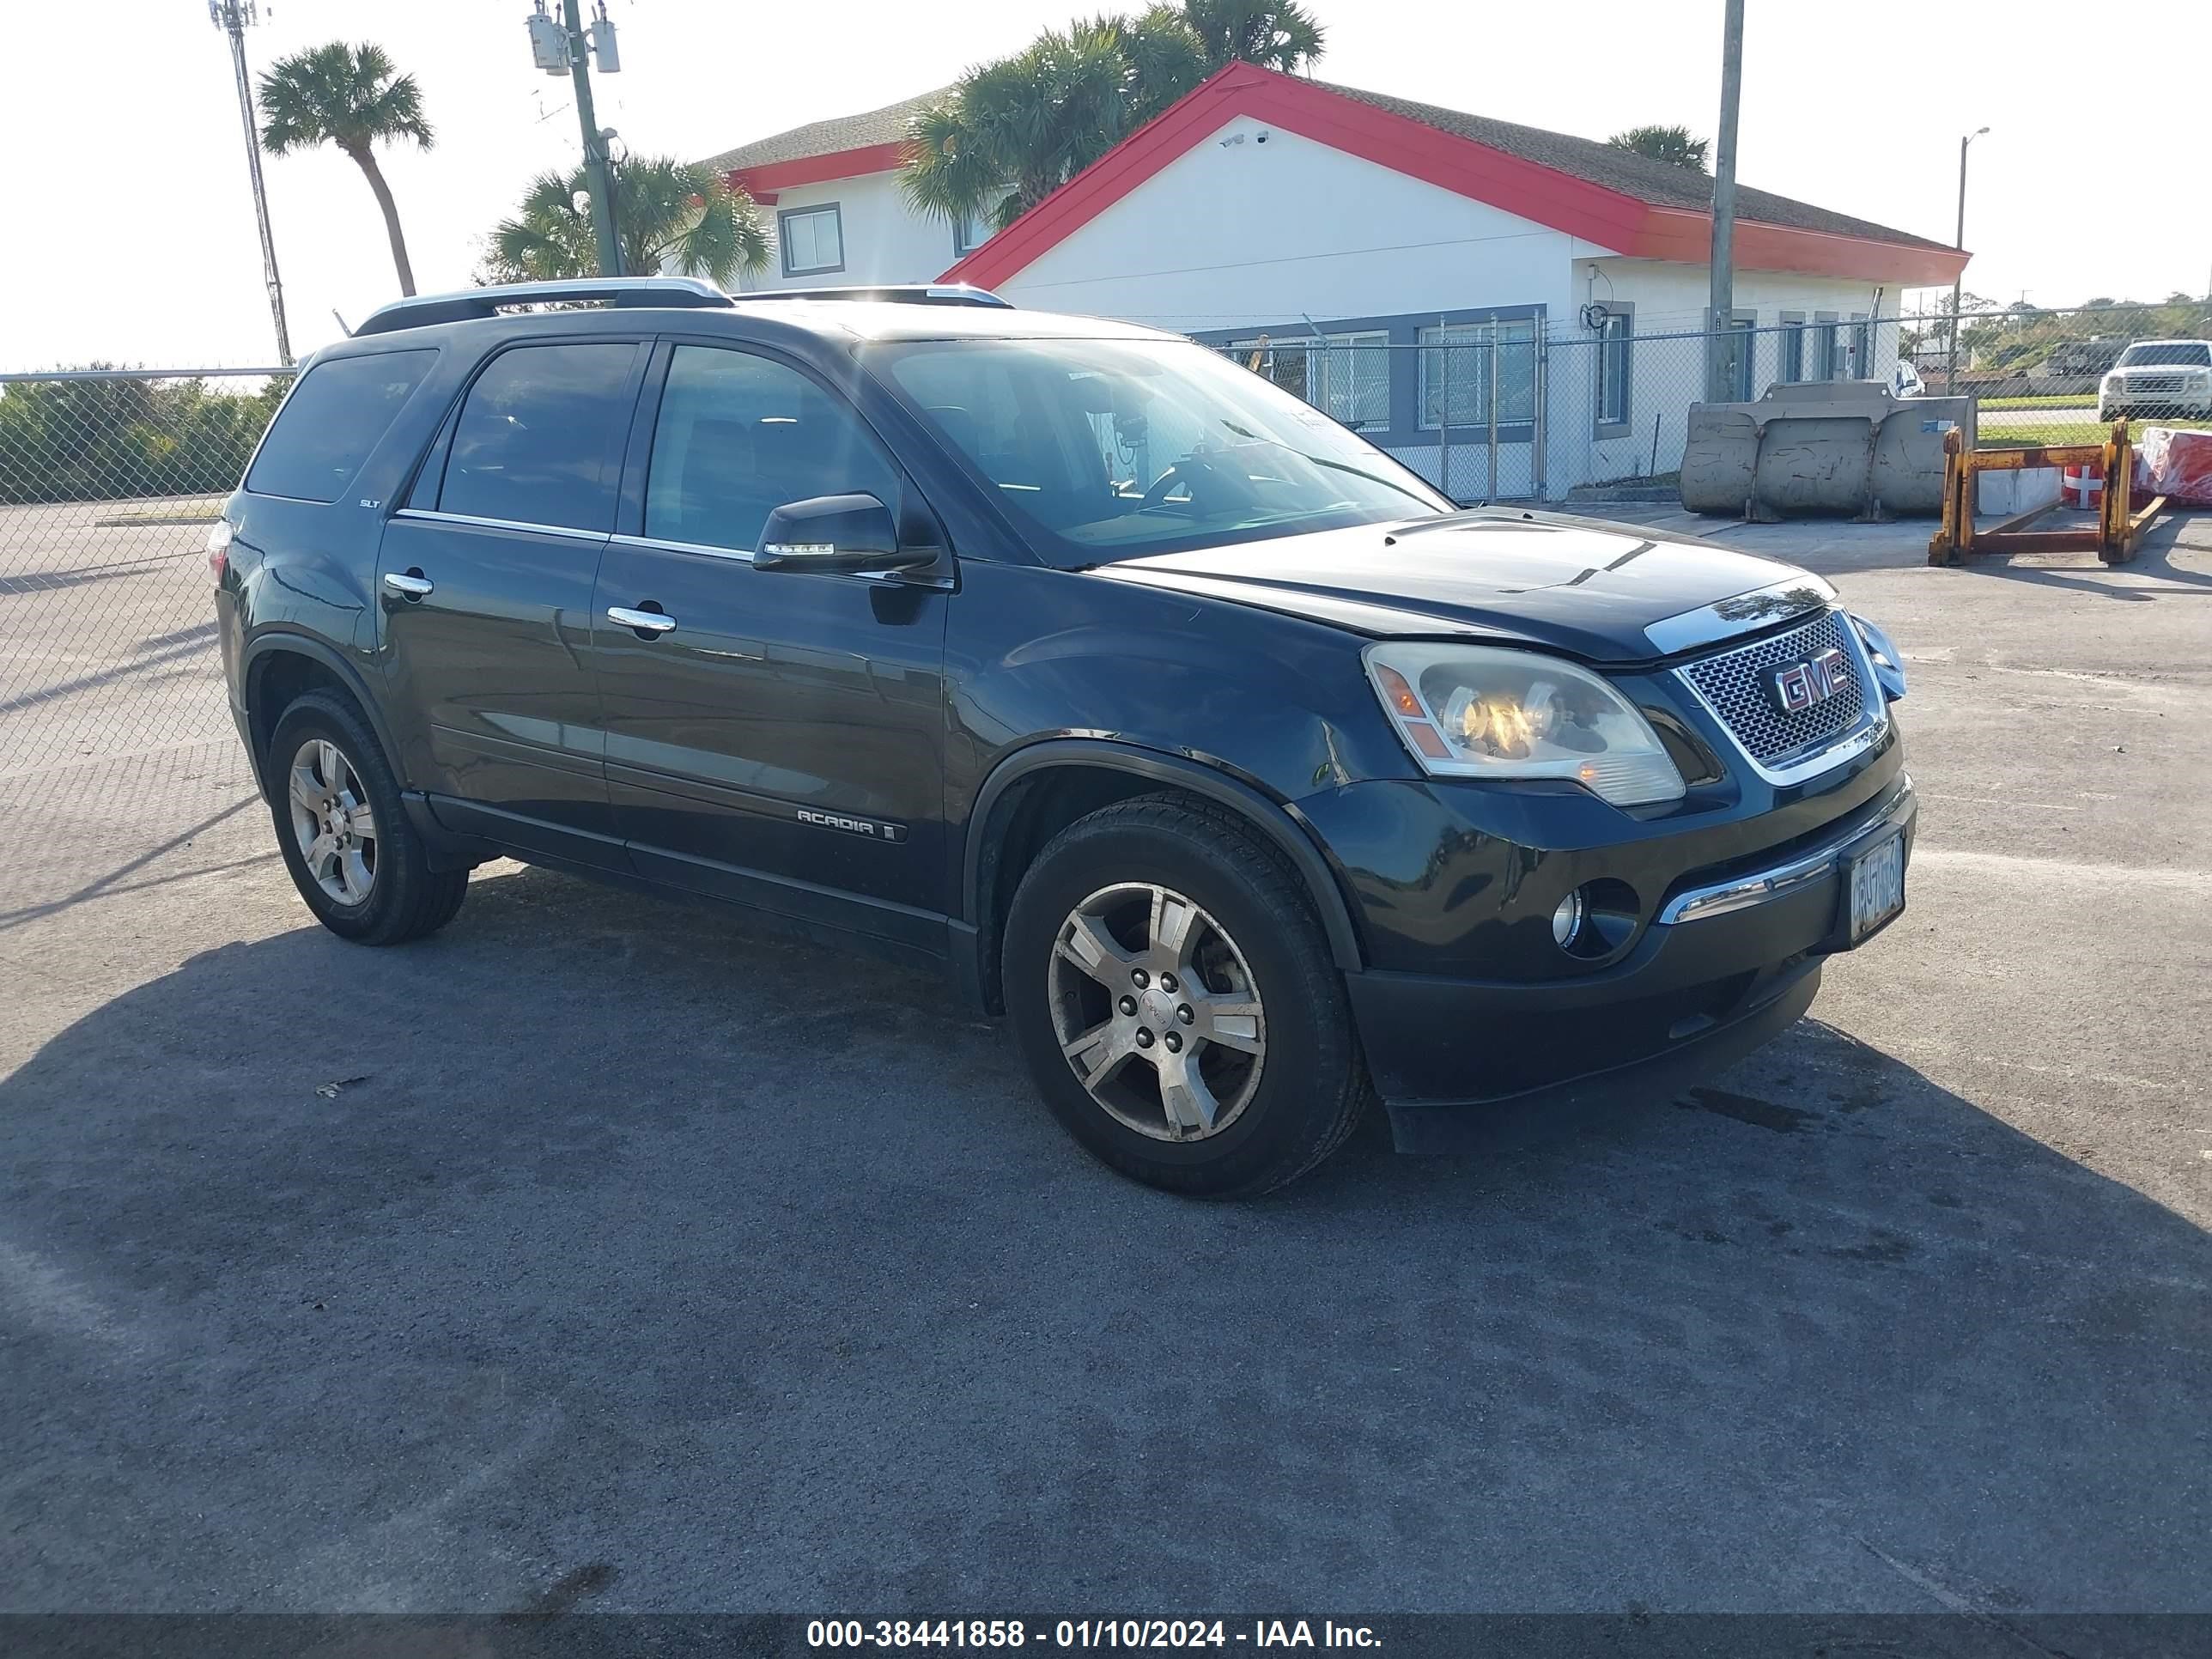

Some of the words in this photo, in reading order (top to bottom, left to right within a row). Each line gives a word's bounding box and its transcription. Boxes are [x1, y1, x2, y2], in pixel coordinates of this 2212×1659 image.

[360, 499, 380, 508] SLT
[1776, 649, 1848, 713] GMC
[797, 810, 874, 835] ACADIA
